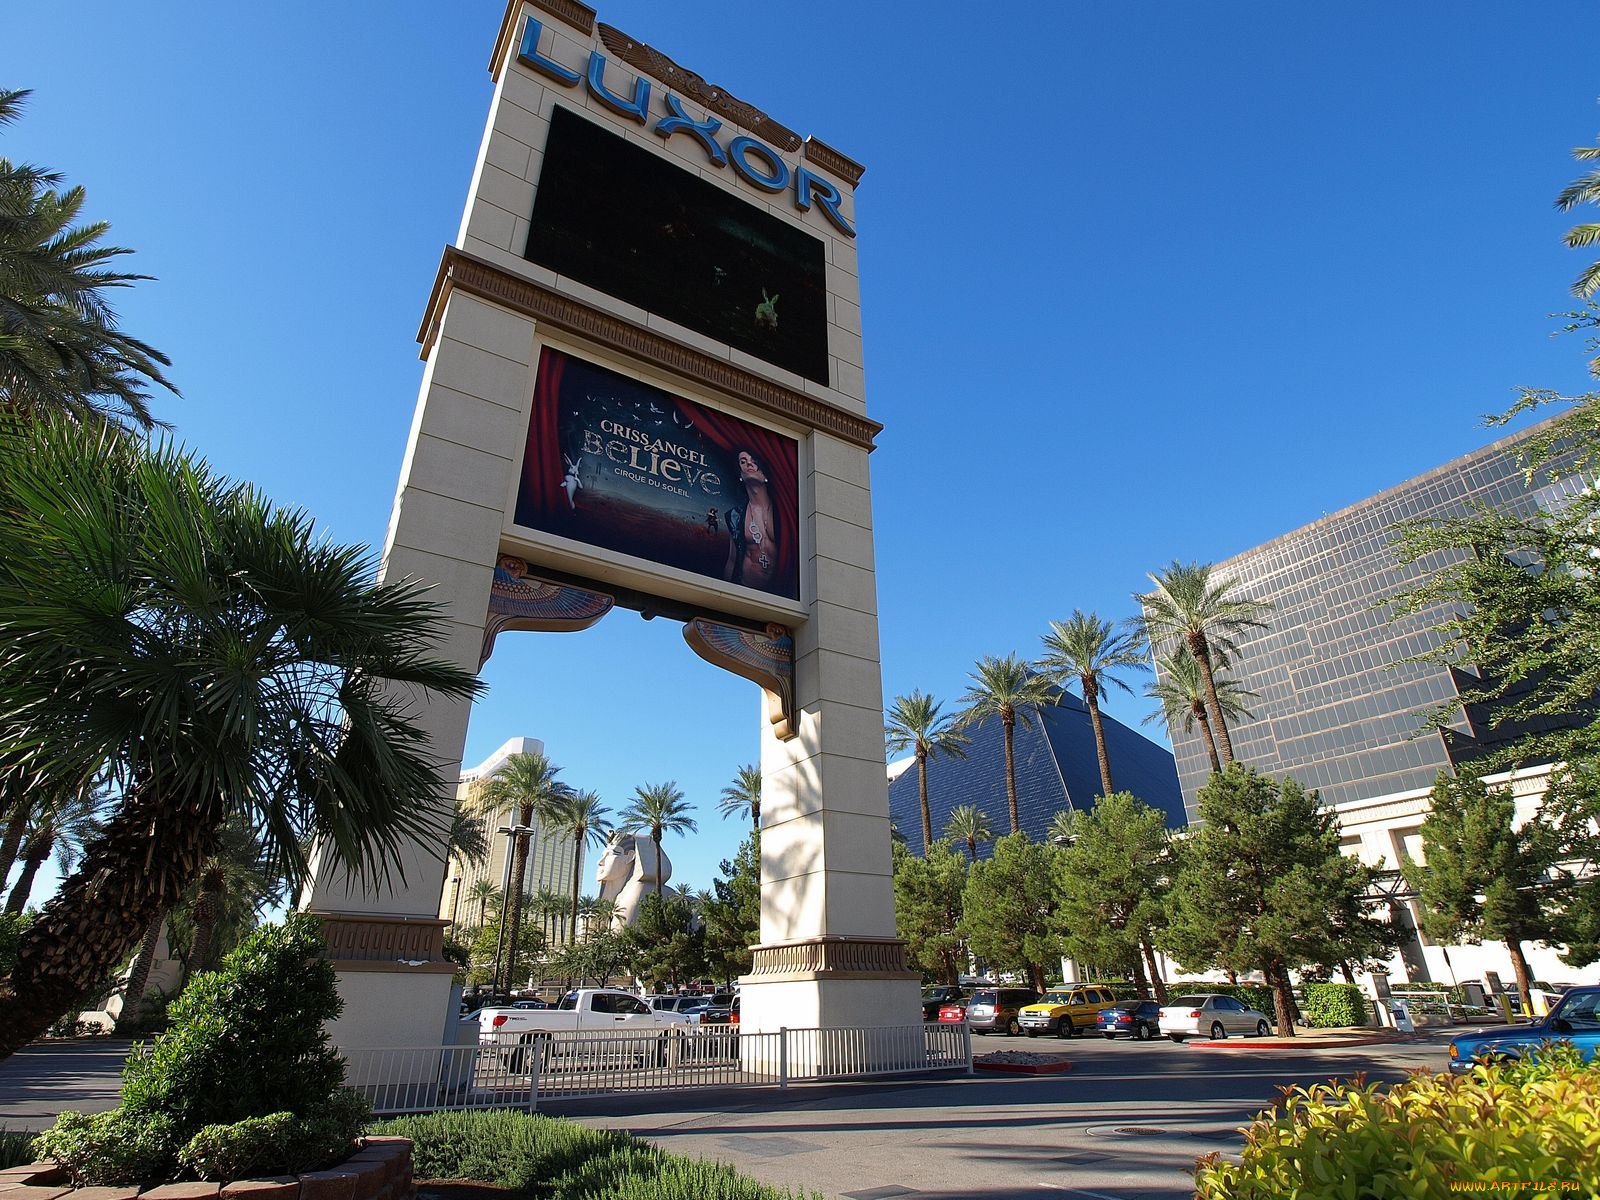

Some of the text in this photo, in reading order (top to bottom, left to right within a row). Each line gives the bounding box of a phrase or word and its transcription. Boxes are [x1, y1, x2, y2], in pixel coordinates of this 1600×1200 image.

[518, 16, 856, 238] LUXOR
[600, 419, 708, 467] CRISS ANGEL
[614, 467, 691, 498] CIRQUE DU SOLEIL
